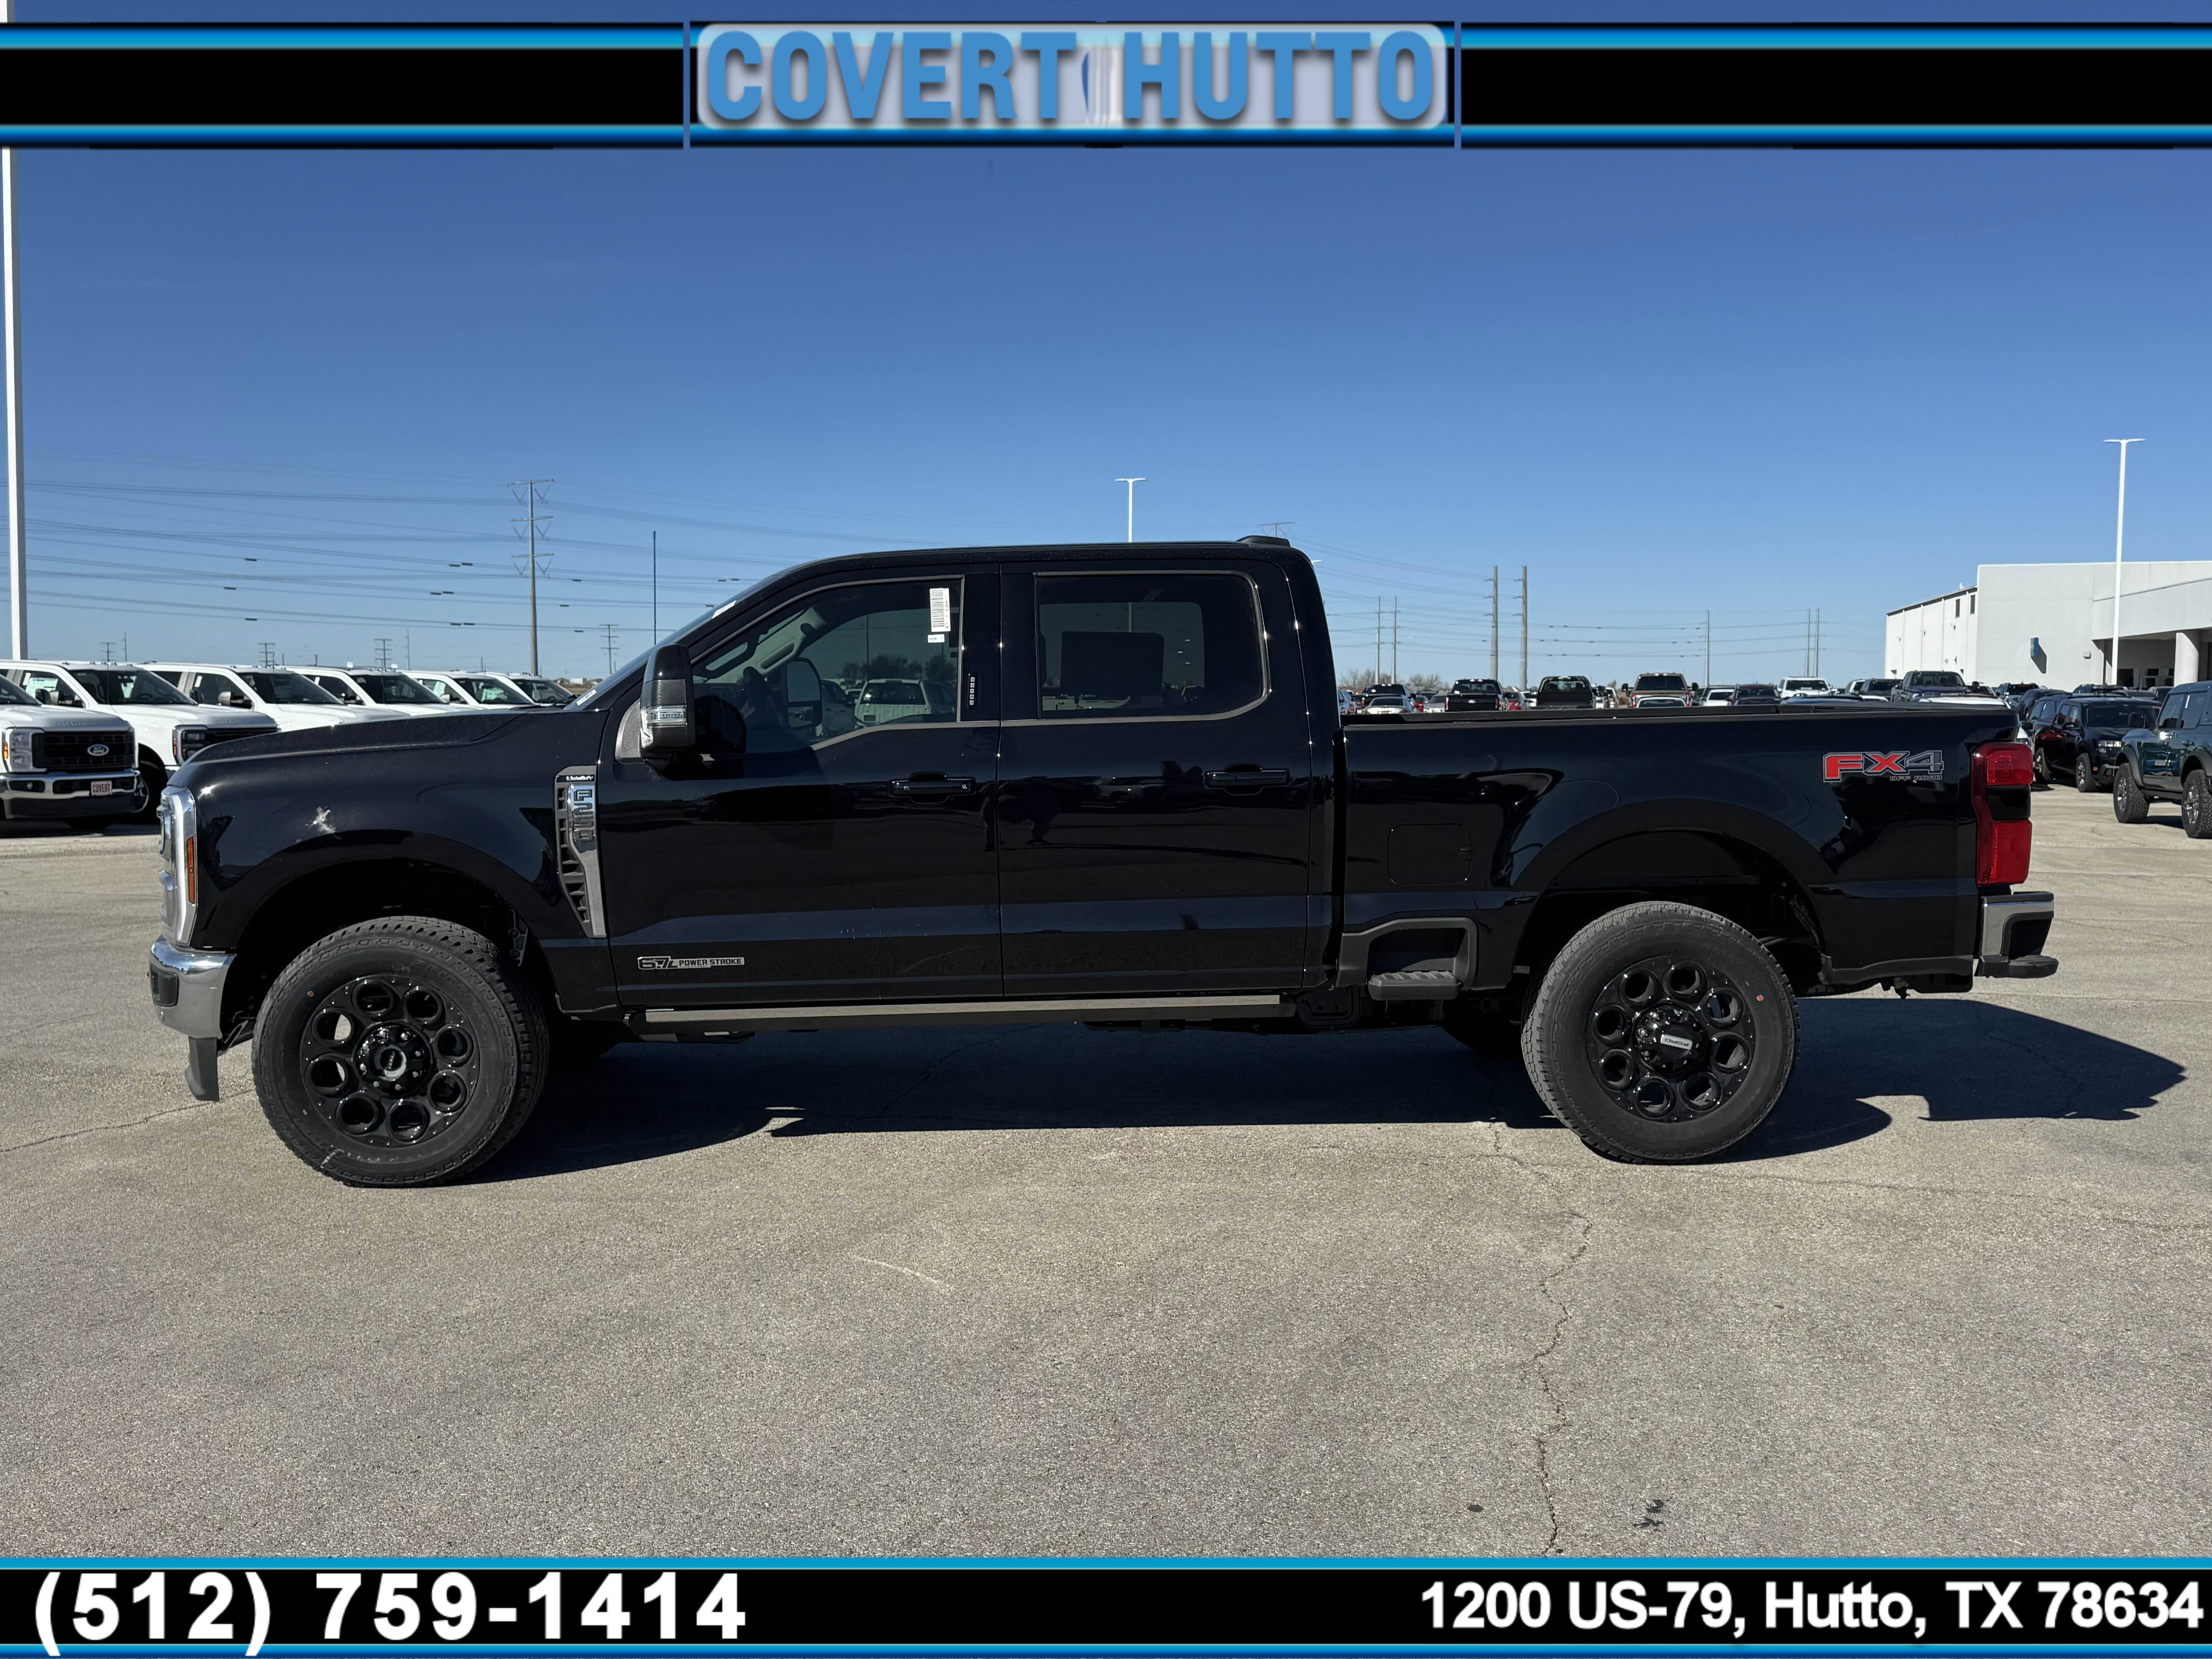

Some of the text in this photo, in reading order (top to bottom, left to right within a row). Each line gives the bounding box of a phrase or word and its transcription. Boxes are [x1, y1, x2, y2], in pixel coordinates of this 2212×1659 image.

[1822, 750, 1944, 783] FX4
[93, 783, 110, 793] COVERT
[1664, 1038, 1689, 1047] FORD
